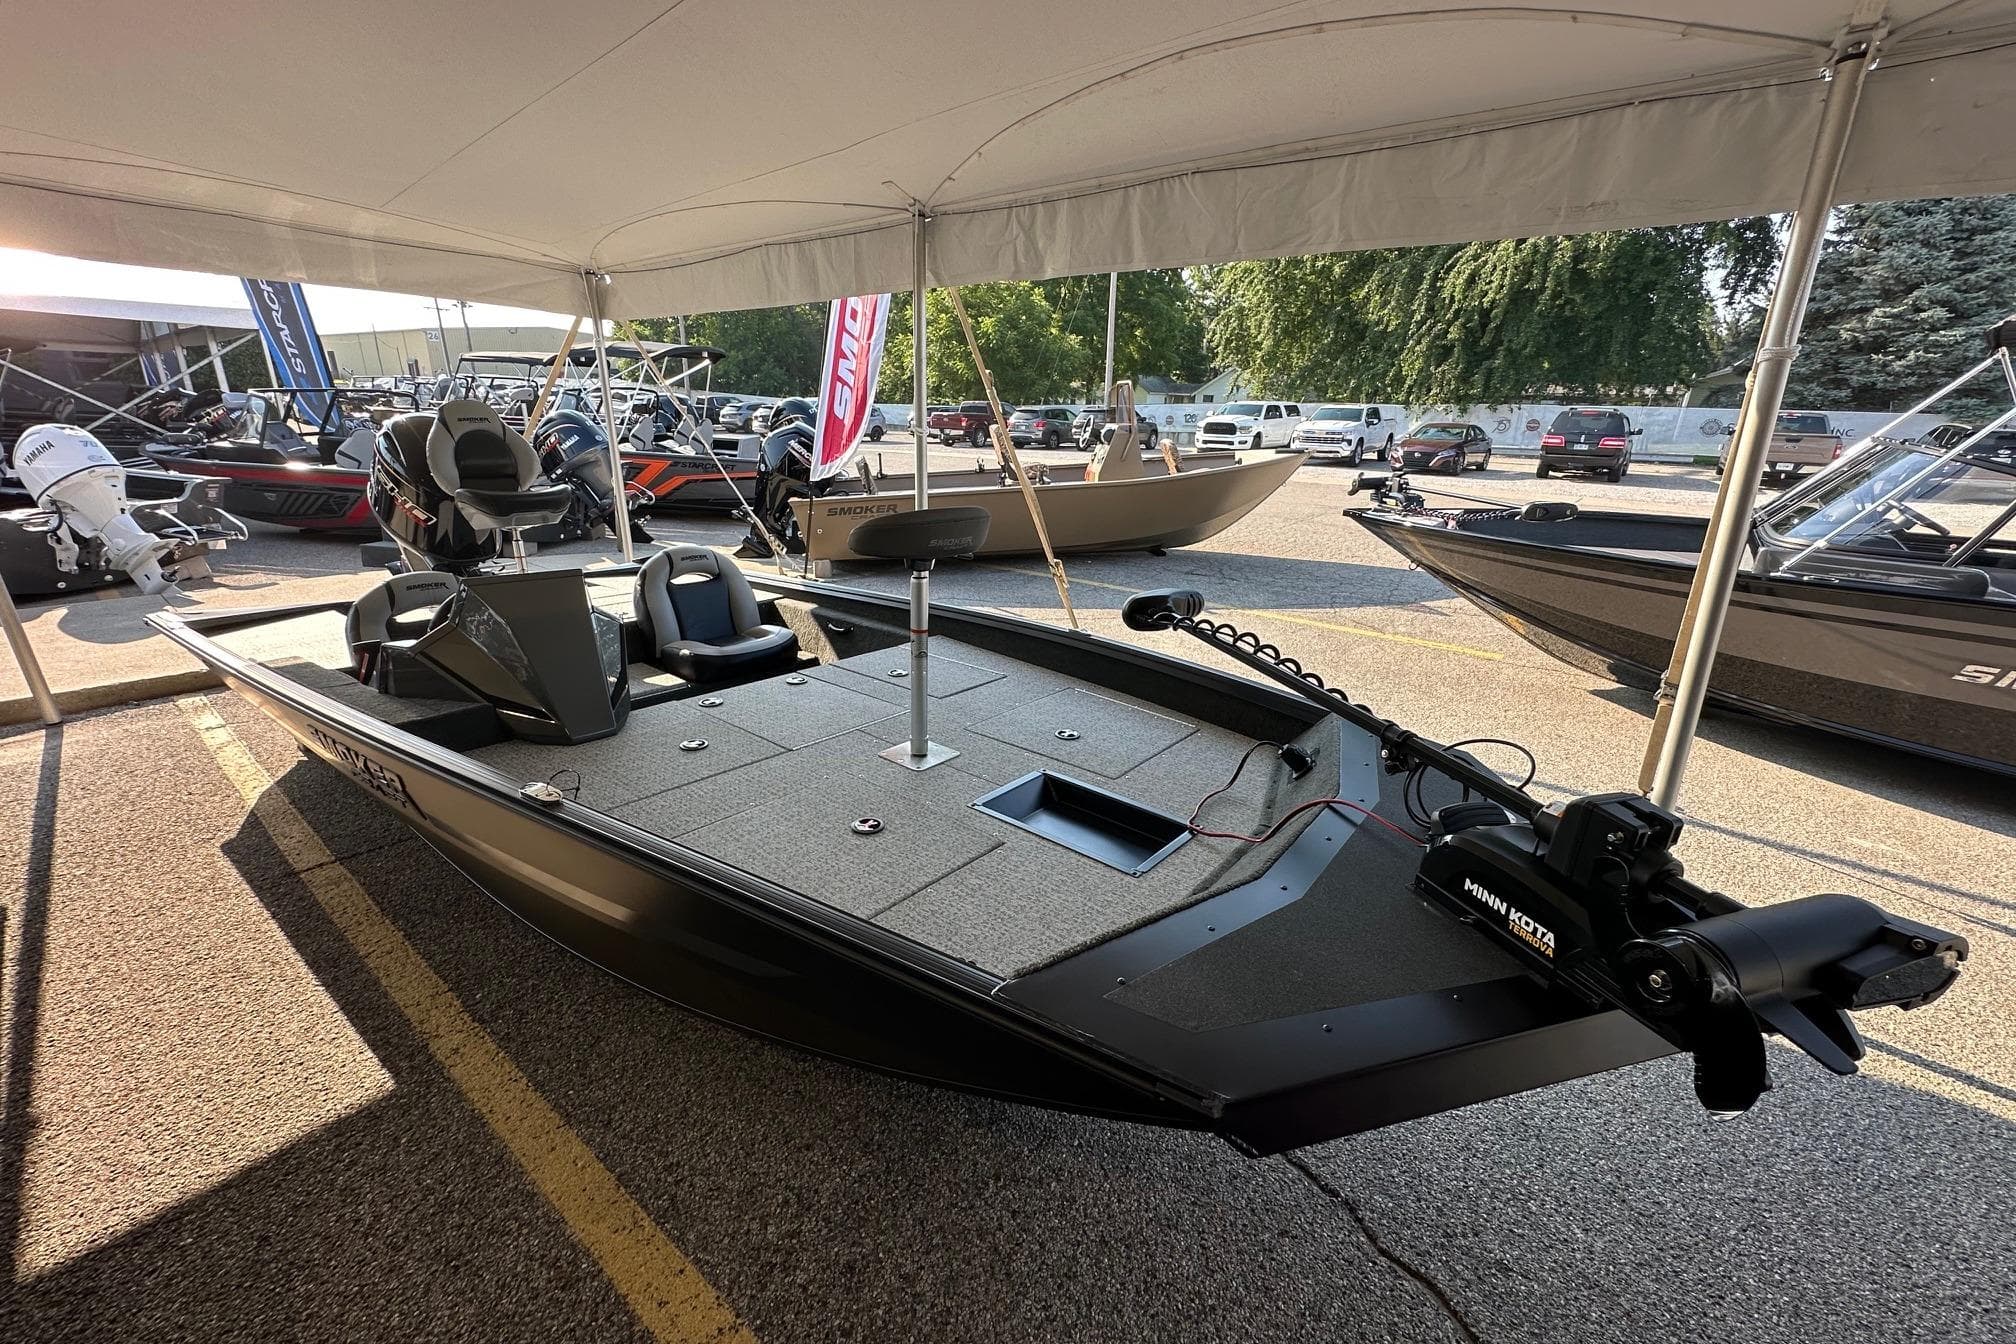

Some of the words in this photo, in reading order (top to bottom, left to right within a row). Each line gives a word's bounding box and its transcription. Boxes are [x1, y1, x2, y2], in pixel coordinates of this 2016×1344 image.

[22, 440, 55, 466] YAMAHA
[826, 503, 899, 517] SMOKER
[406, 582, 449, 591] SMOKER
[1464, 877, 1508, 915] MINN
[1508, 907, 1555, 949] KOTA
[1508, 920, 1554, 958] TERROVA
